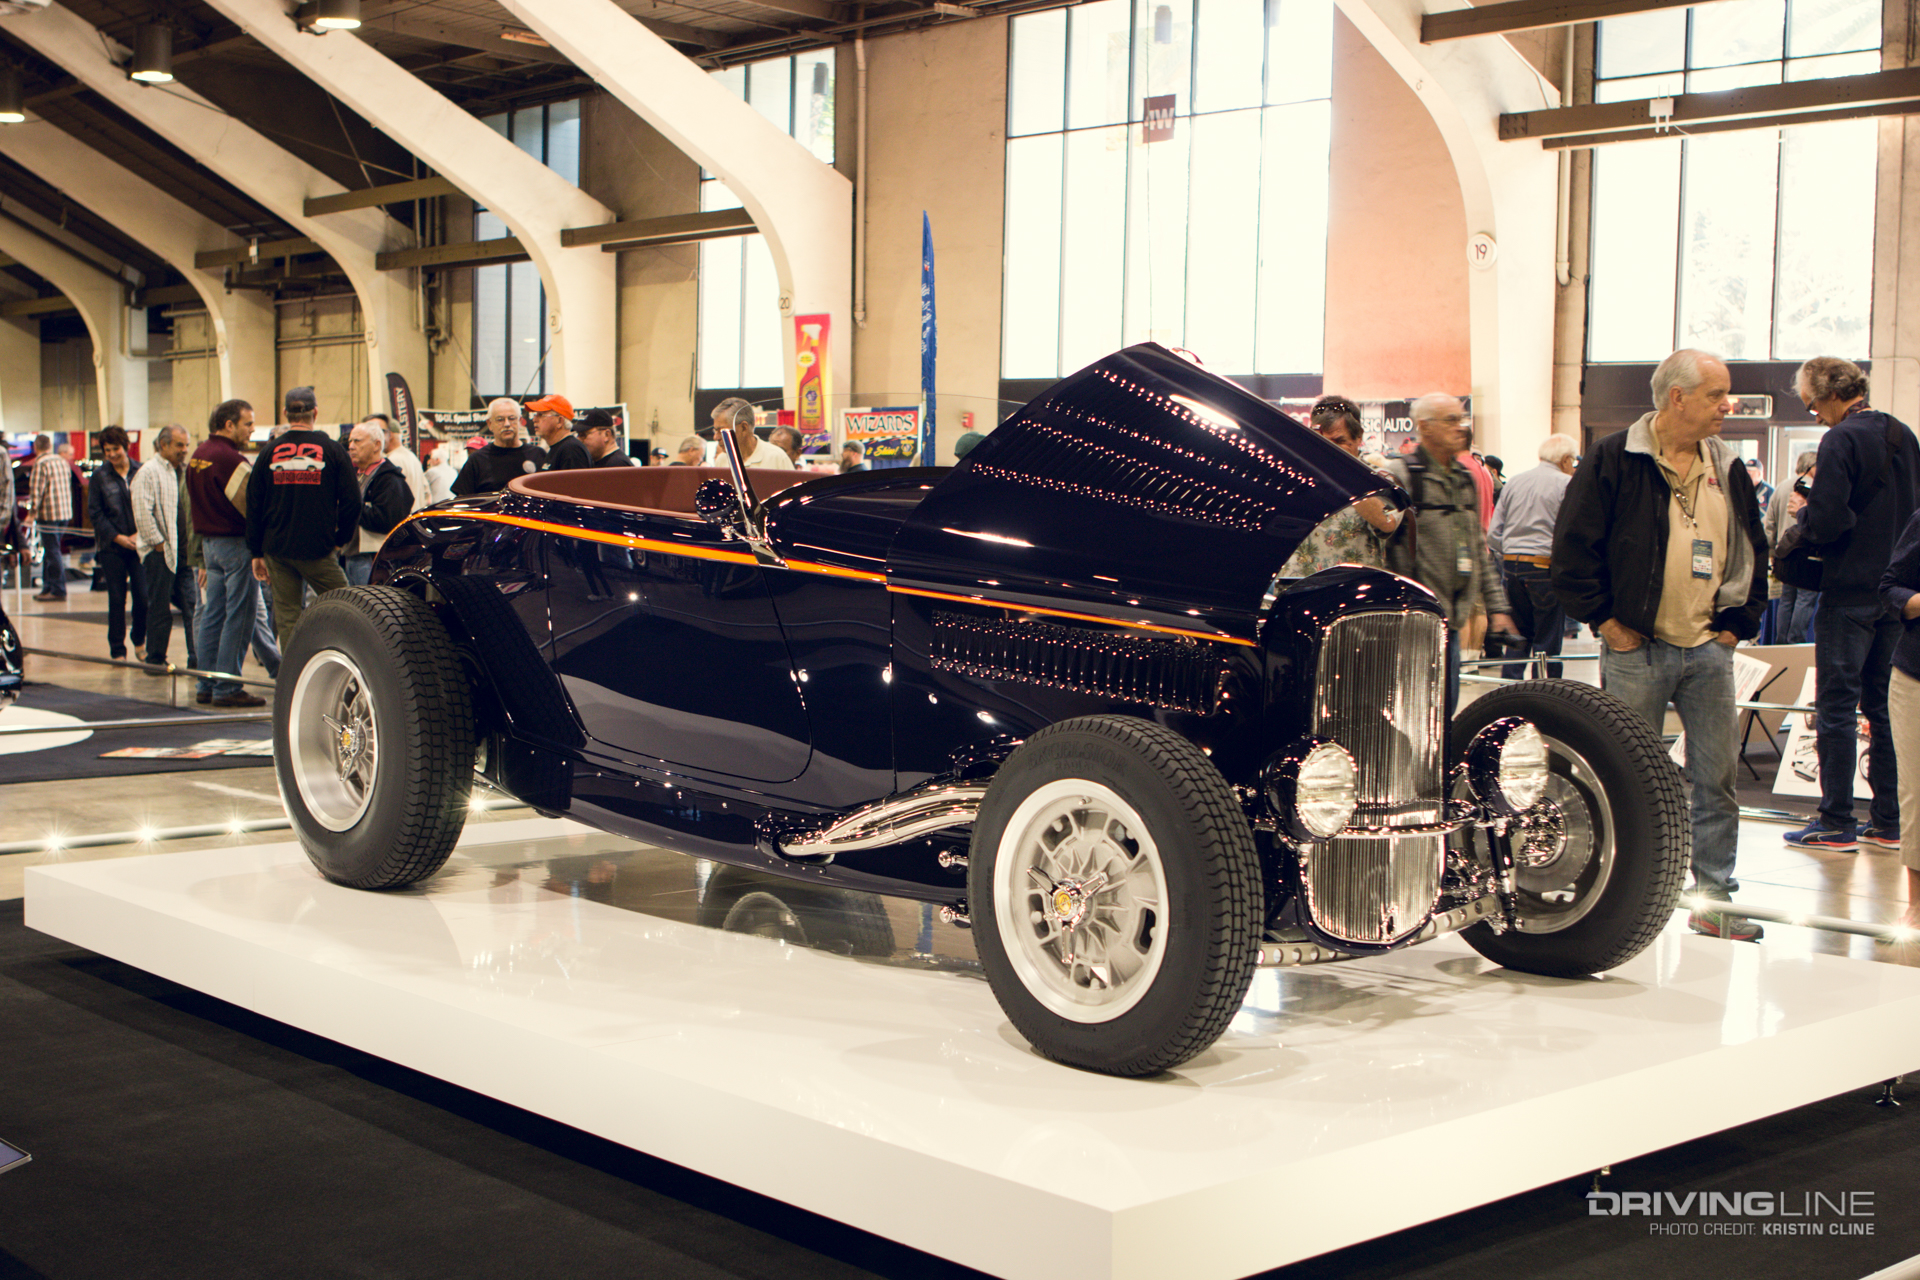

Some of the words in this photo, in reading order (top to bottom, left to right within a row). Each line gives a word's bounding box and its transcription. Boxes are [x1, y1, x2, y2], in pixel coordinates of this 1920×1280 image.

[1475, 243, 1488, 260] 19
[780, 296, 790, 310] 20
[846, 414, 914, 431] WIZARDS
[1384, 417, 1413, 432] AUTO
[1027, 741, 1127, 777] EXCELSIOR
